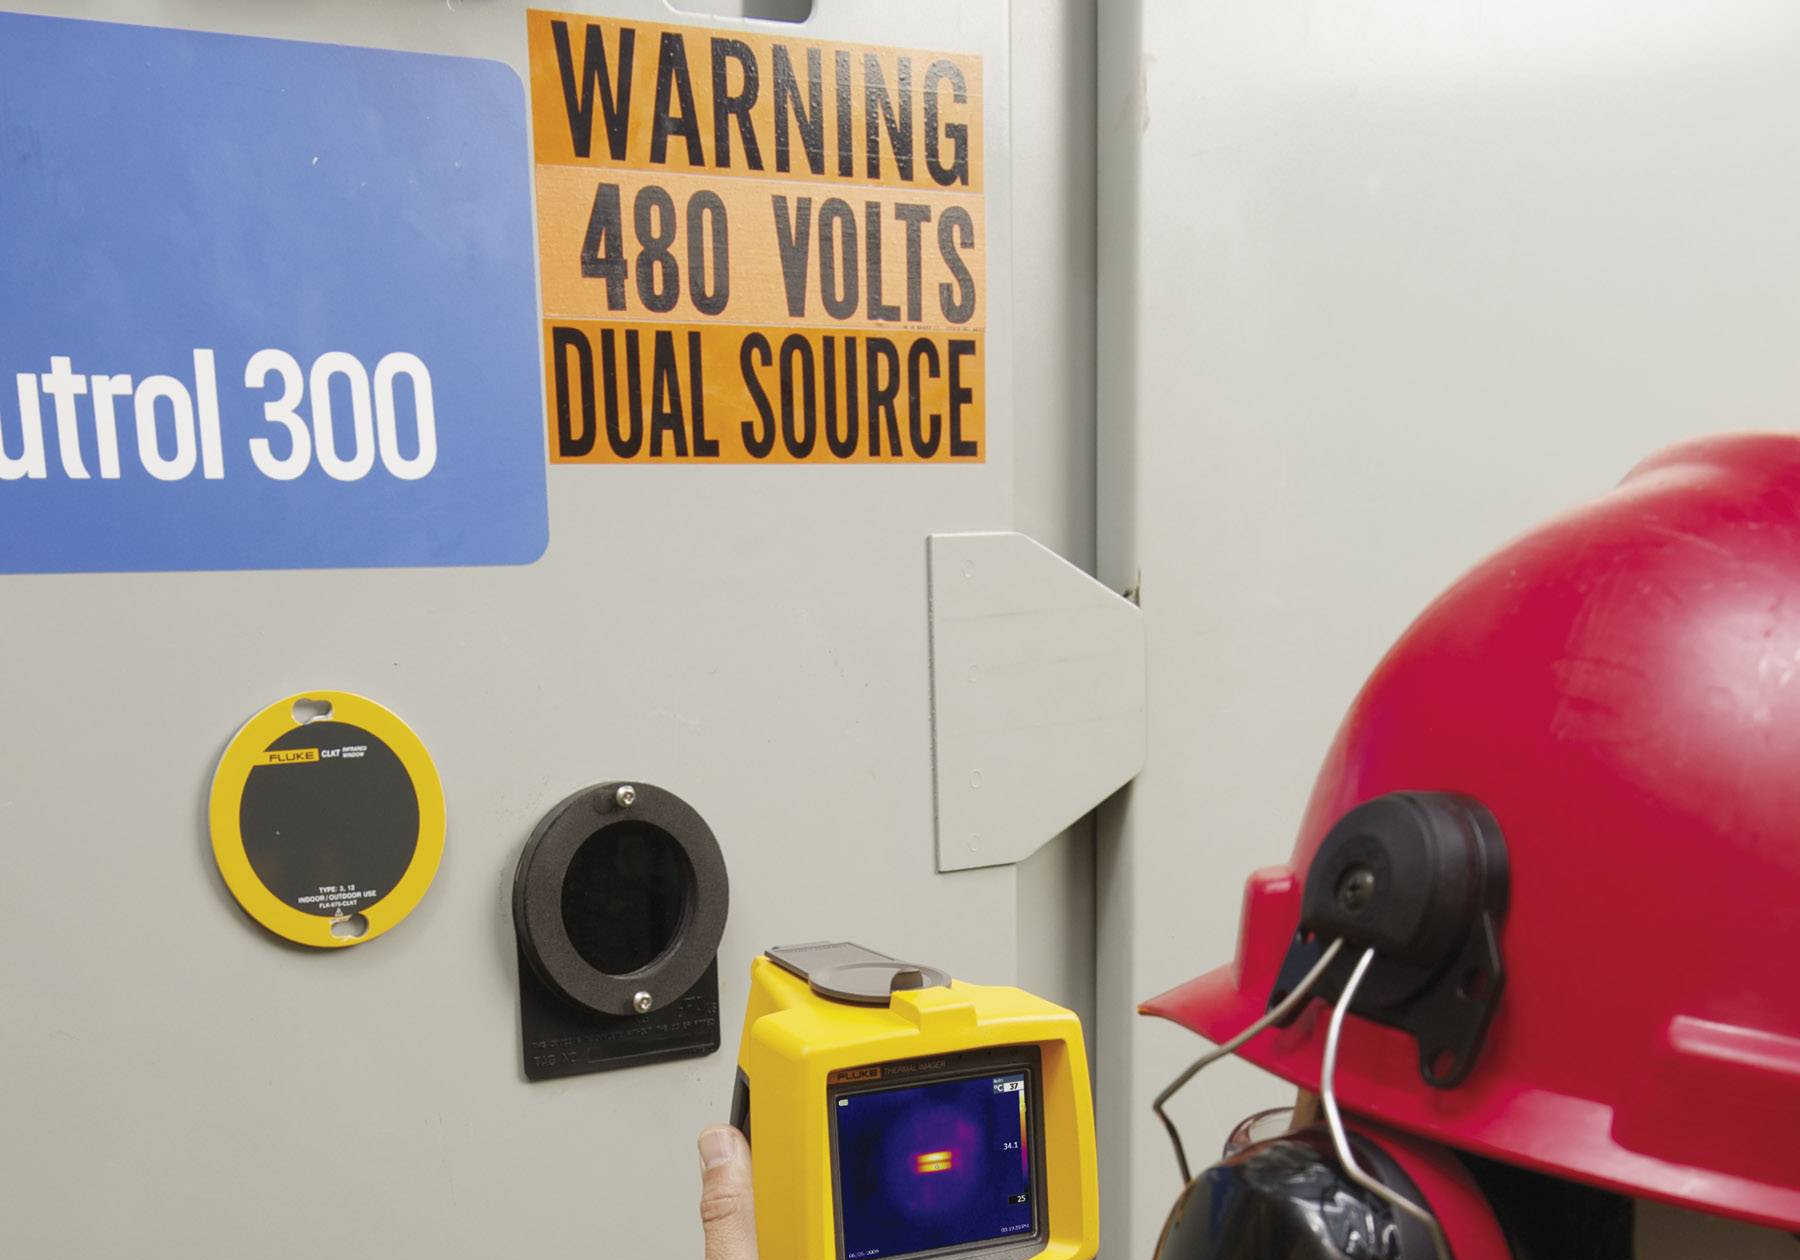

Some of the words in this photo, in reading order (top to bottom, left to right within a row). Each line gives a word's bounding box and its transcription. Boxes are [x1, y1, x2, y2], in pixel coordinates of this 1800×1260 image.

[551, 19, 970, 187] WARNING
[581, 182, 729, 316] 480
[771, 194, 976, 323] VOLTS
[552, 327, 720, 459] DUAL
[739, 332, 978, 459] SOURCE
[244, 348, 438, 482] 300
[269, 751, 314, 763] FLUKE
[321, 748, 341, 759] CLKT
[319, 886, 338, 894] TYPE:
[363, 890, 377, 898] USE
[837, 1069, 879, 1081] FLUKE
[1009, 1082, 1019, 1090] 37
[1003, 1141, 1019, 1150] 34.1
[1017, 1195, 1026, 1203] 25
